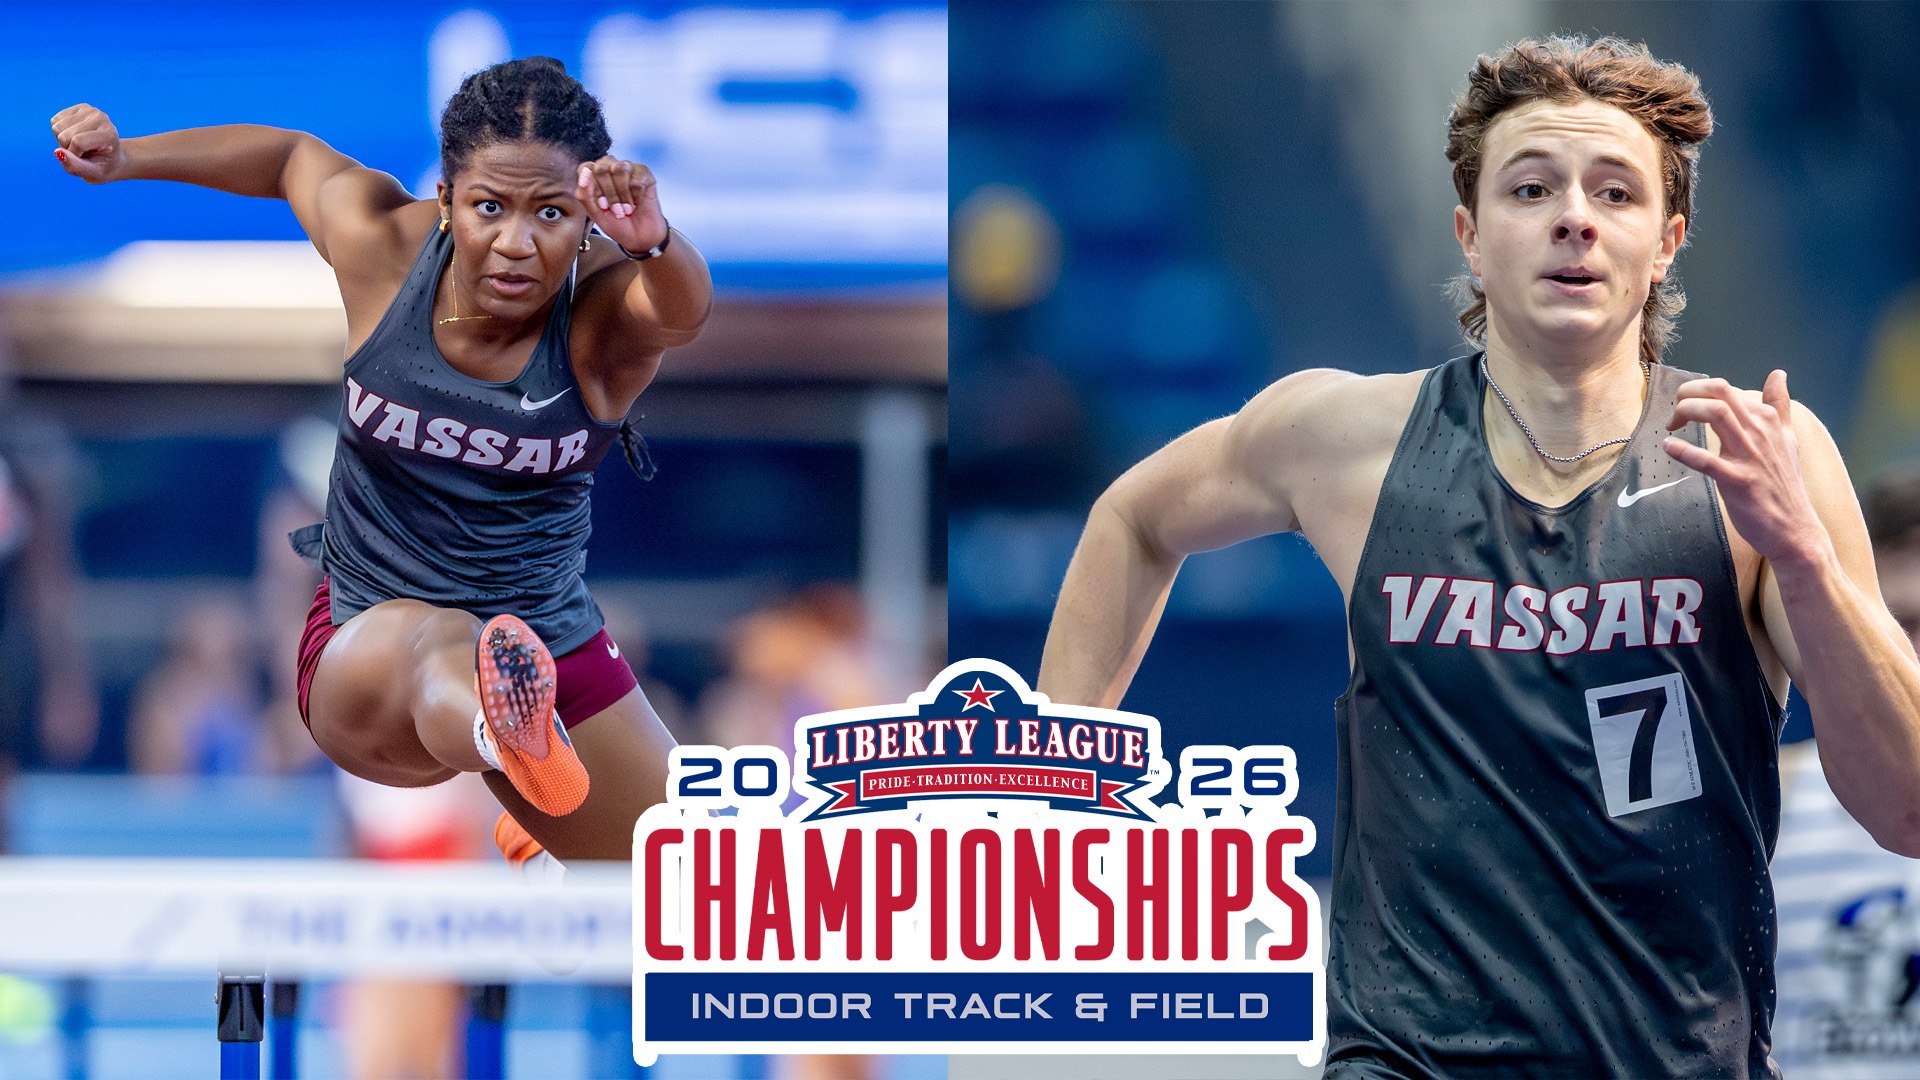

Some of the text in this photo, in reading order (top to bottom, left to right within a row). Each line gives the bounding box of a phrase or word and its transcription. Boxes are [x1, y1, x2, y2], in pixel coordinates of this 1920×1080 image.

[346, 375, 590, 475] VASSAR
[1381, 573, 1704, 657] VASSAR
[1596, 686, 1669, 804] 7
